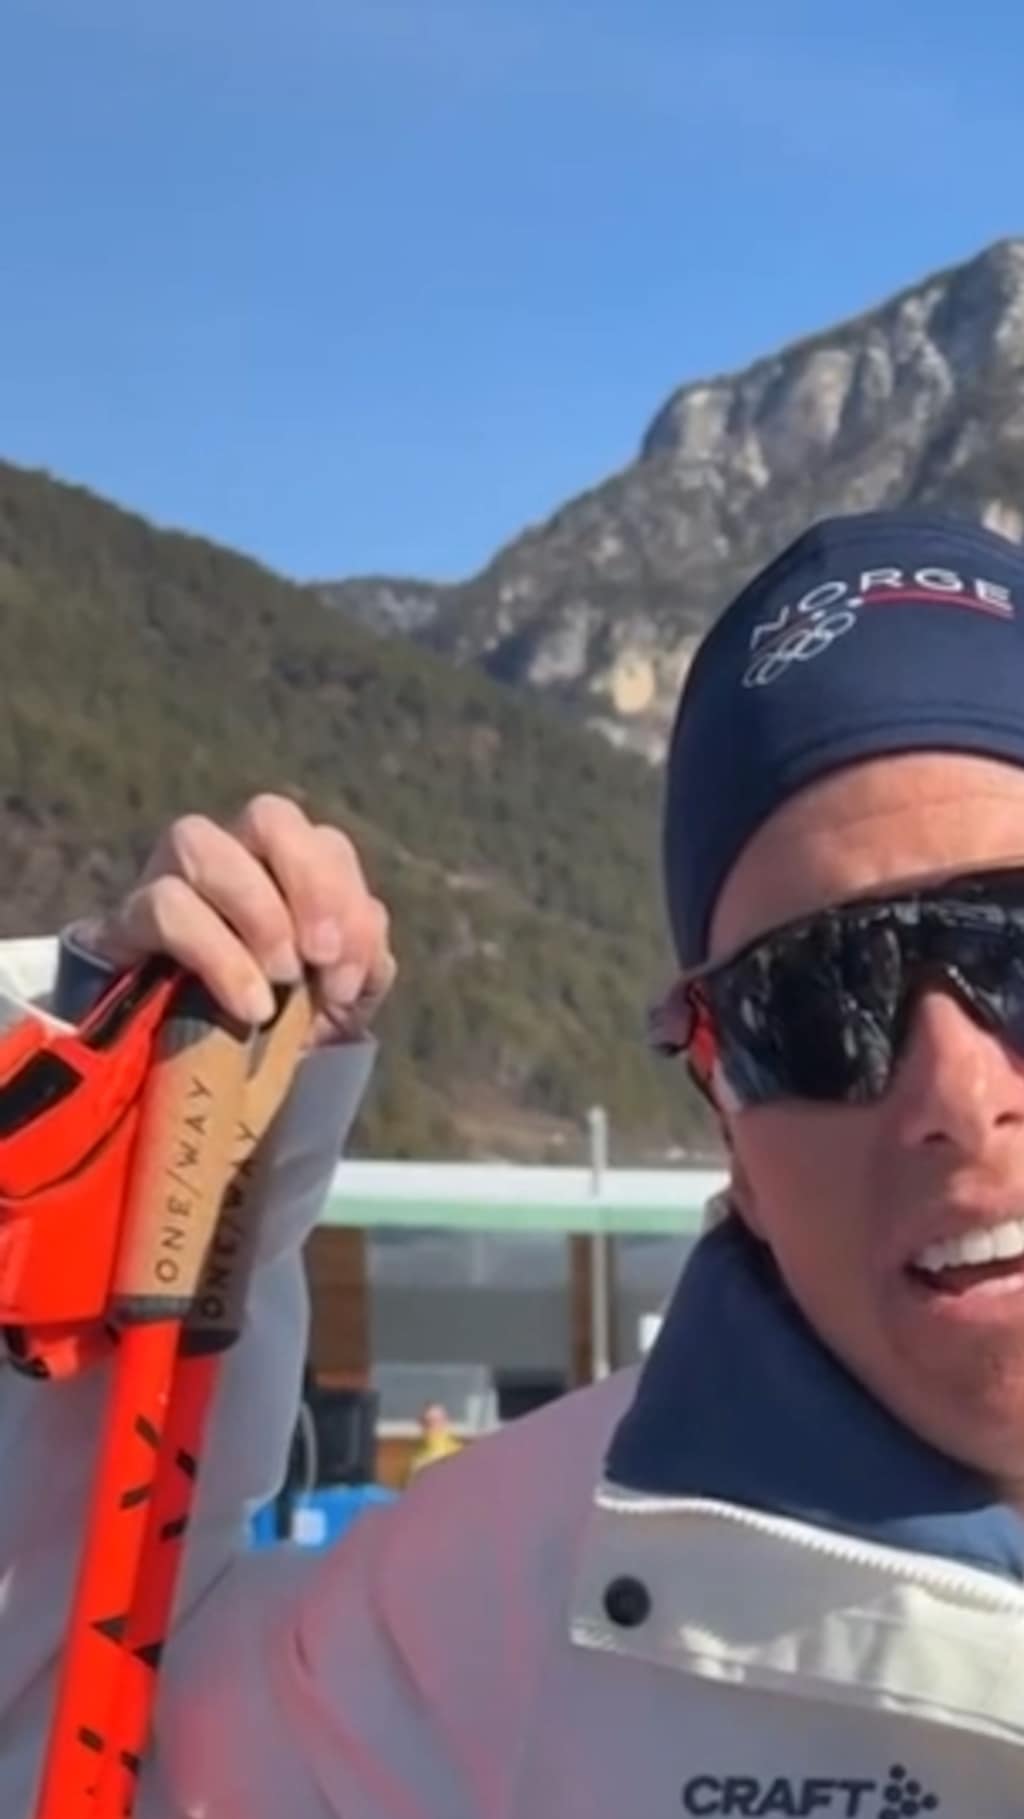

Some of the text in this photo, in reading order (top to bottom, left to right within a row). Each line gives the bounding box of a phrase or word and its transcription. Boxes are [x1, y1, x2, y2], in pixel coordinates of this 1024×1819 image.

[750, 567, 1014, 651] NORGE
[154, 1077, 212, 1284] ONE/WAY
[682, 1774, 876, 1819] CRAFT
